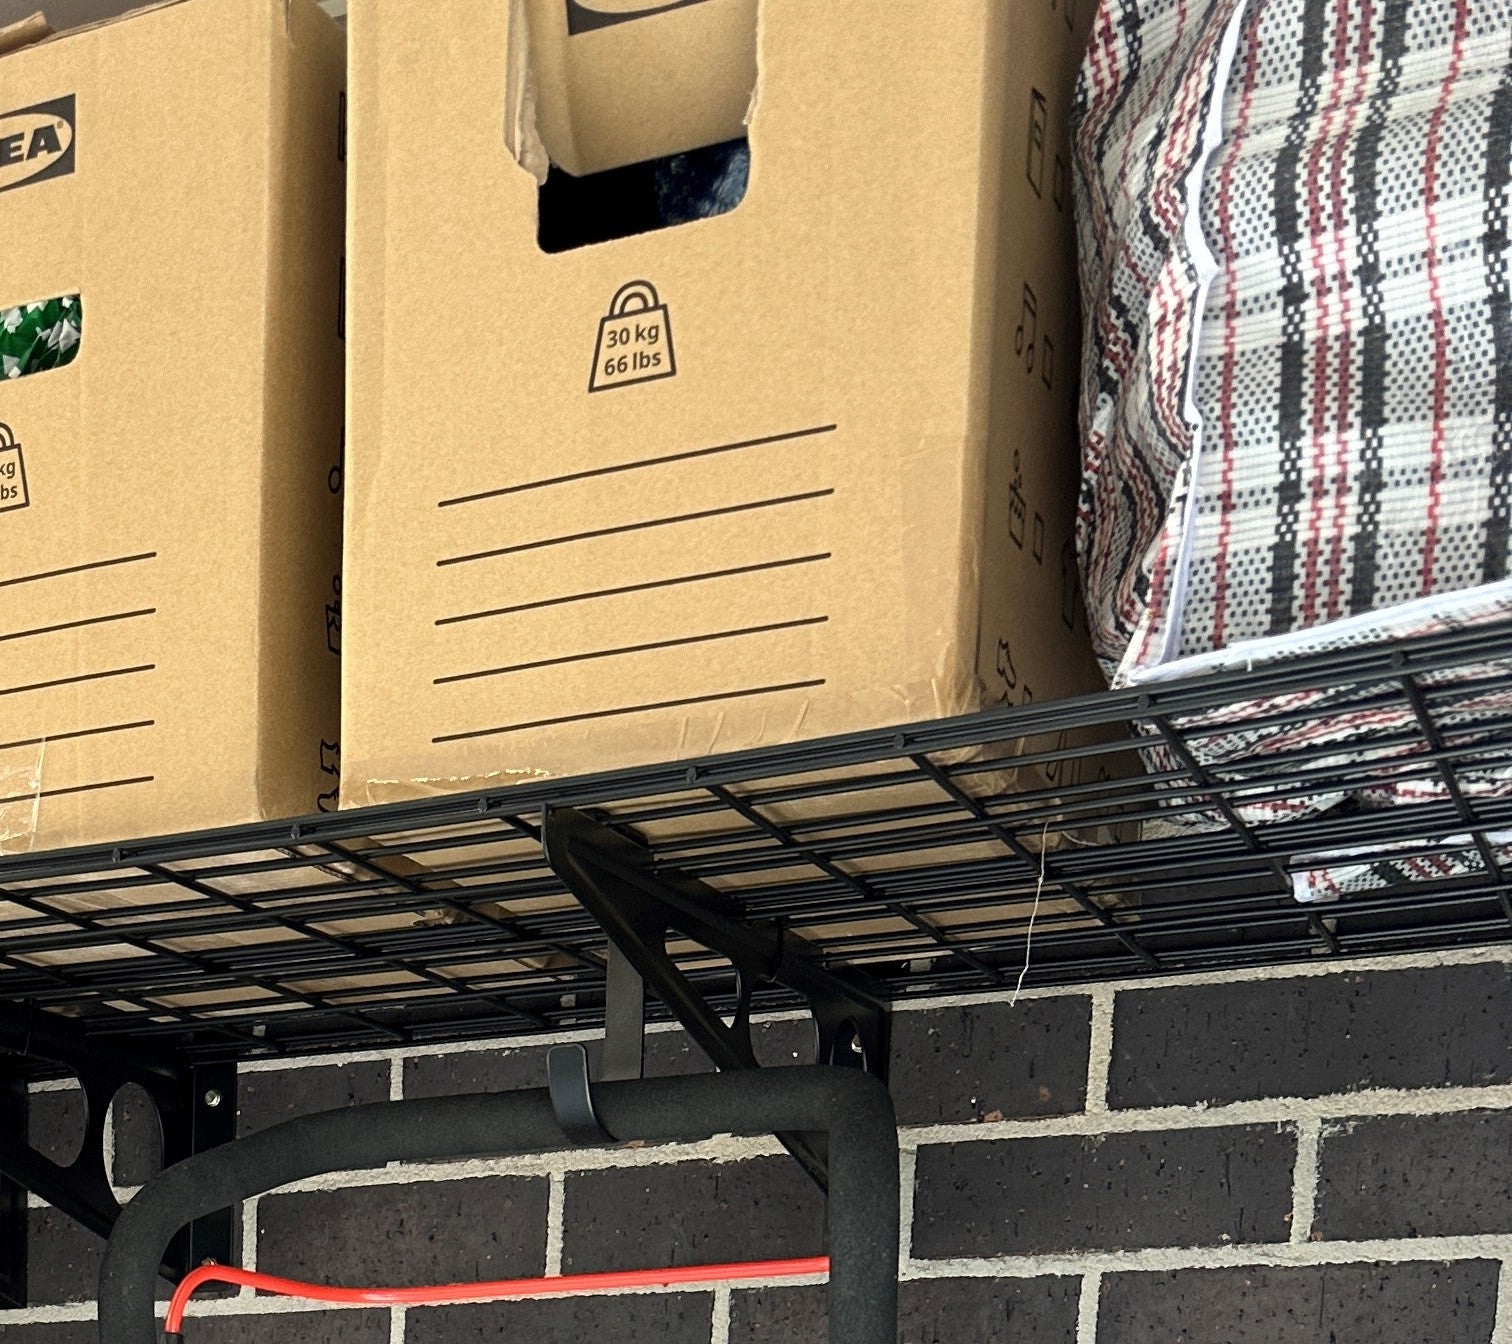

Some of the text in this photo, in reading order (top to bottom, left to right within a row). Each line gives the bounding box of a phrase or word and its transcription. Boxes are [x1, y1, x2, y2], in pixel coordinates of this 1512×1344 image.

[605, 321, 660, 350] 30 kg
[603, 347, 663, 377] 66 lbs
